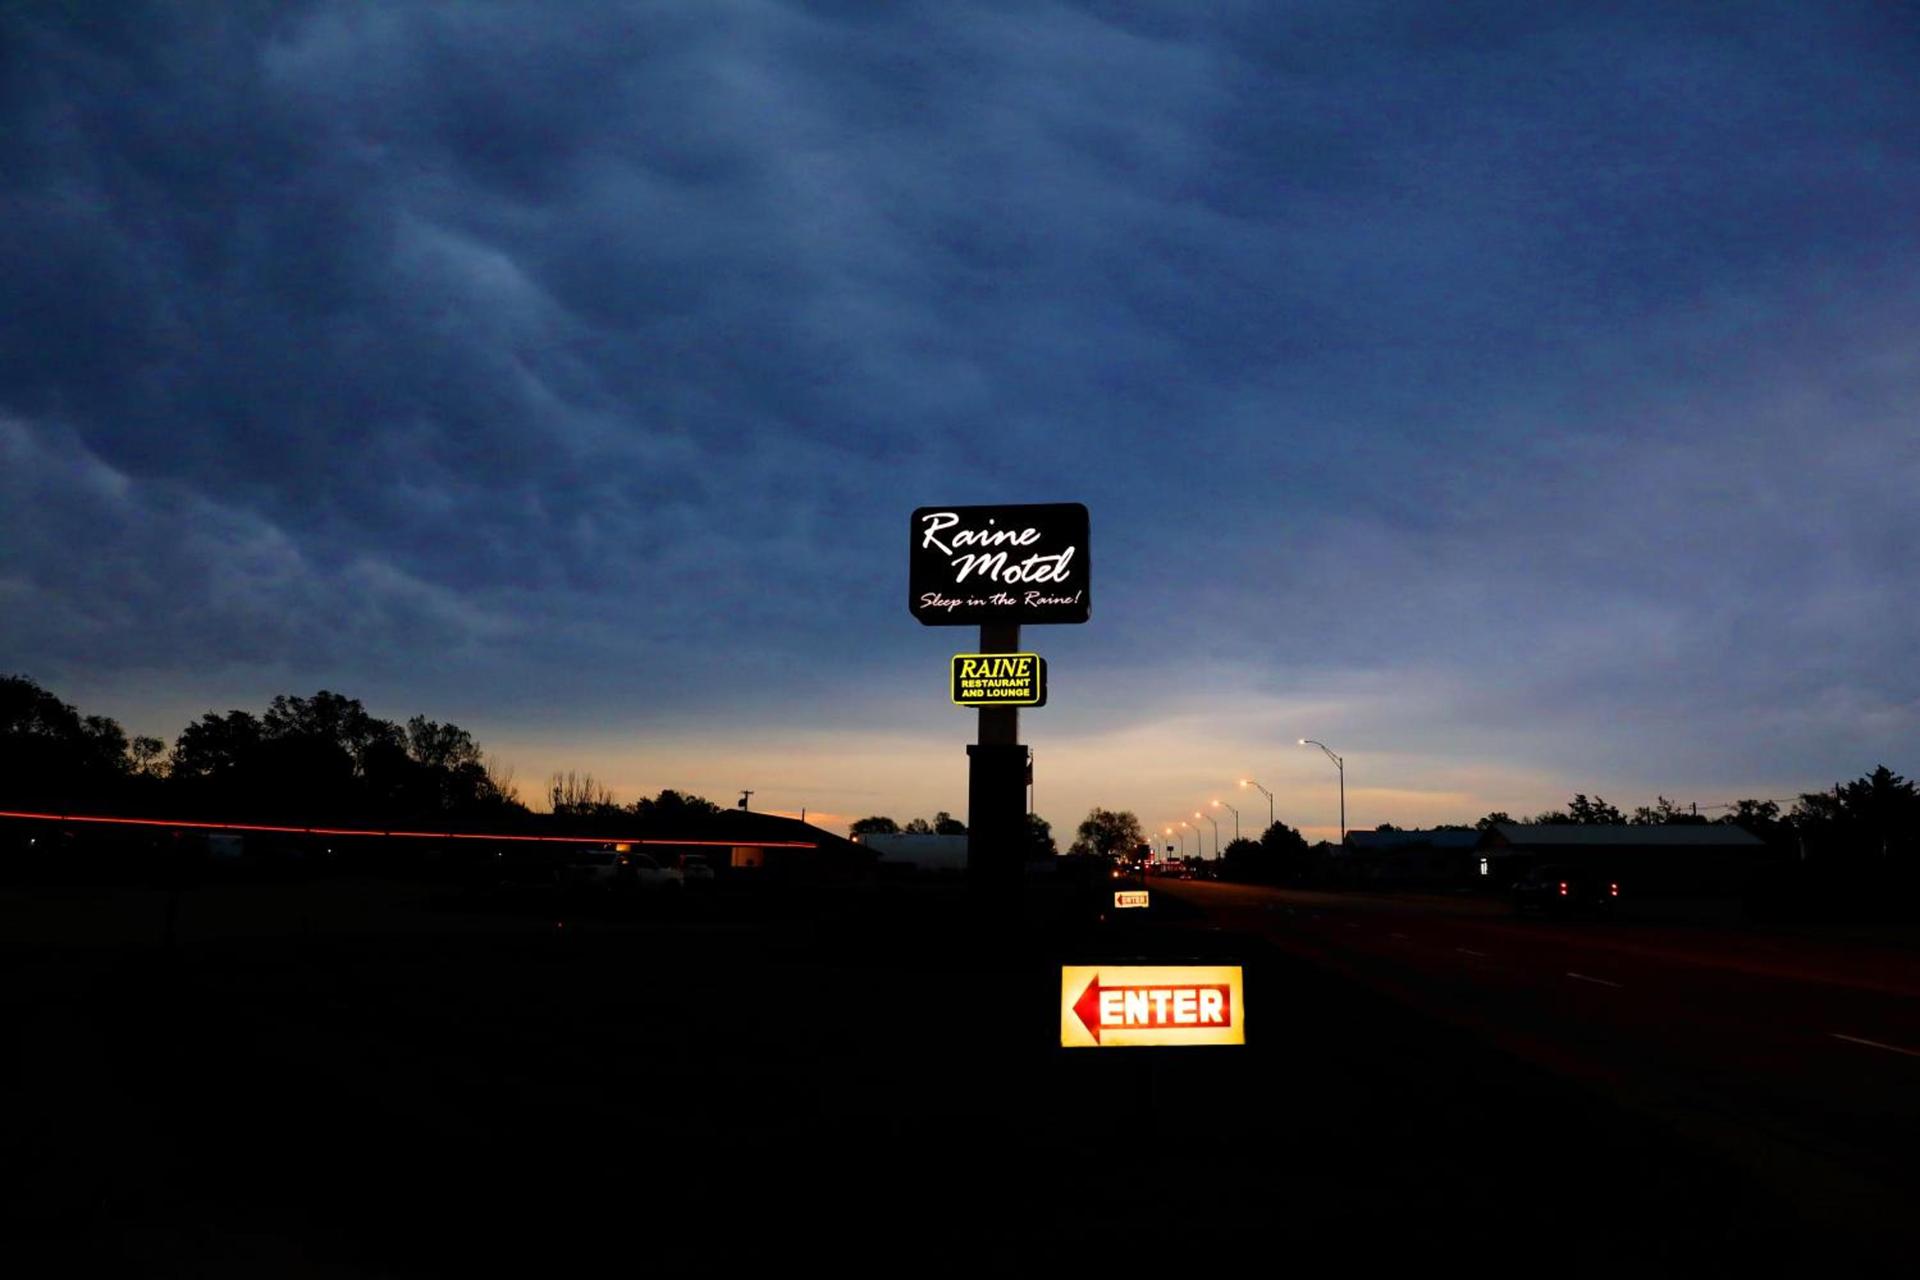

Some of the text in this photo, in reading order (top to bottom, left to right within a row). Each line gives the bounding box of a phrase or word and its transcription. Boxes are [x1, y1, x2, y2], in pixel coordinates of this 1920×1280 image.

[922, 512, 1041, 556] Raine
[951, 546, 1076, 584] Motel
[920, 590, 1082, 613] Sleep in the Raine!
[960, 658, 1032, 678] RAINE
[961, 678, 1031, 688] RESTAURANT
[962, 688, 1030, 697] AND LOUNGE
[1121, 895, 1146, 905] ENTER
[1099, 989, 1224, 1025] ENTER
